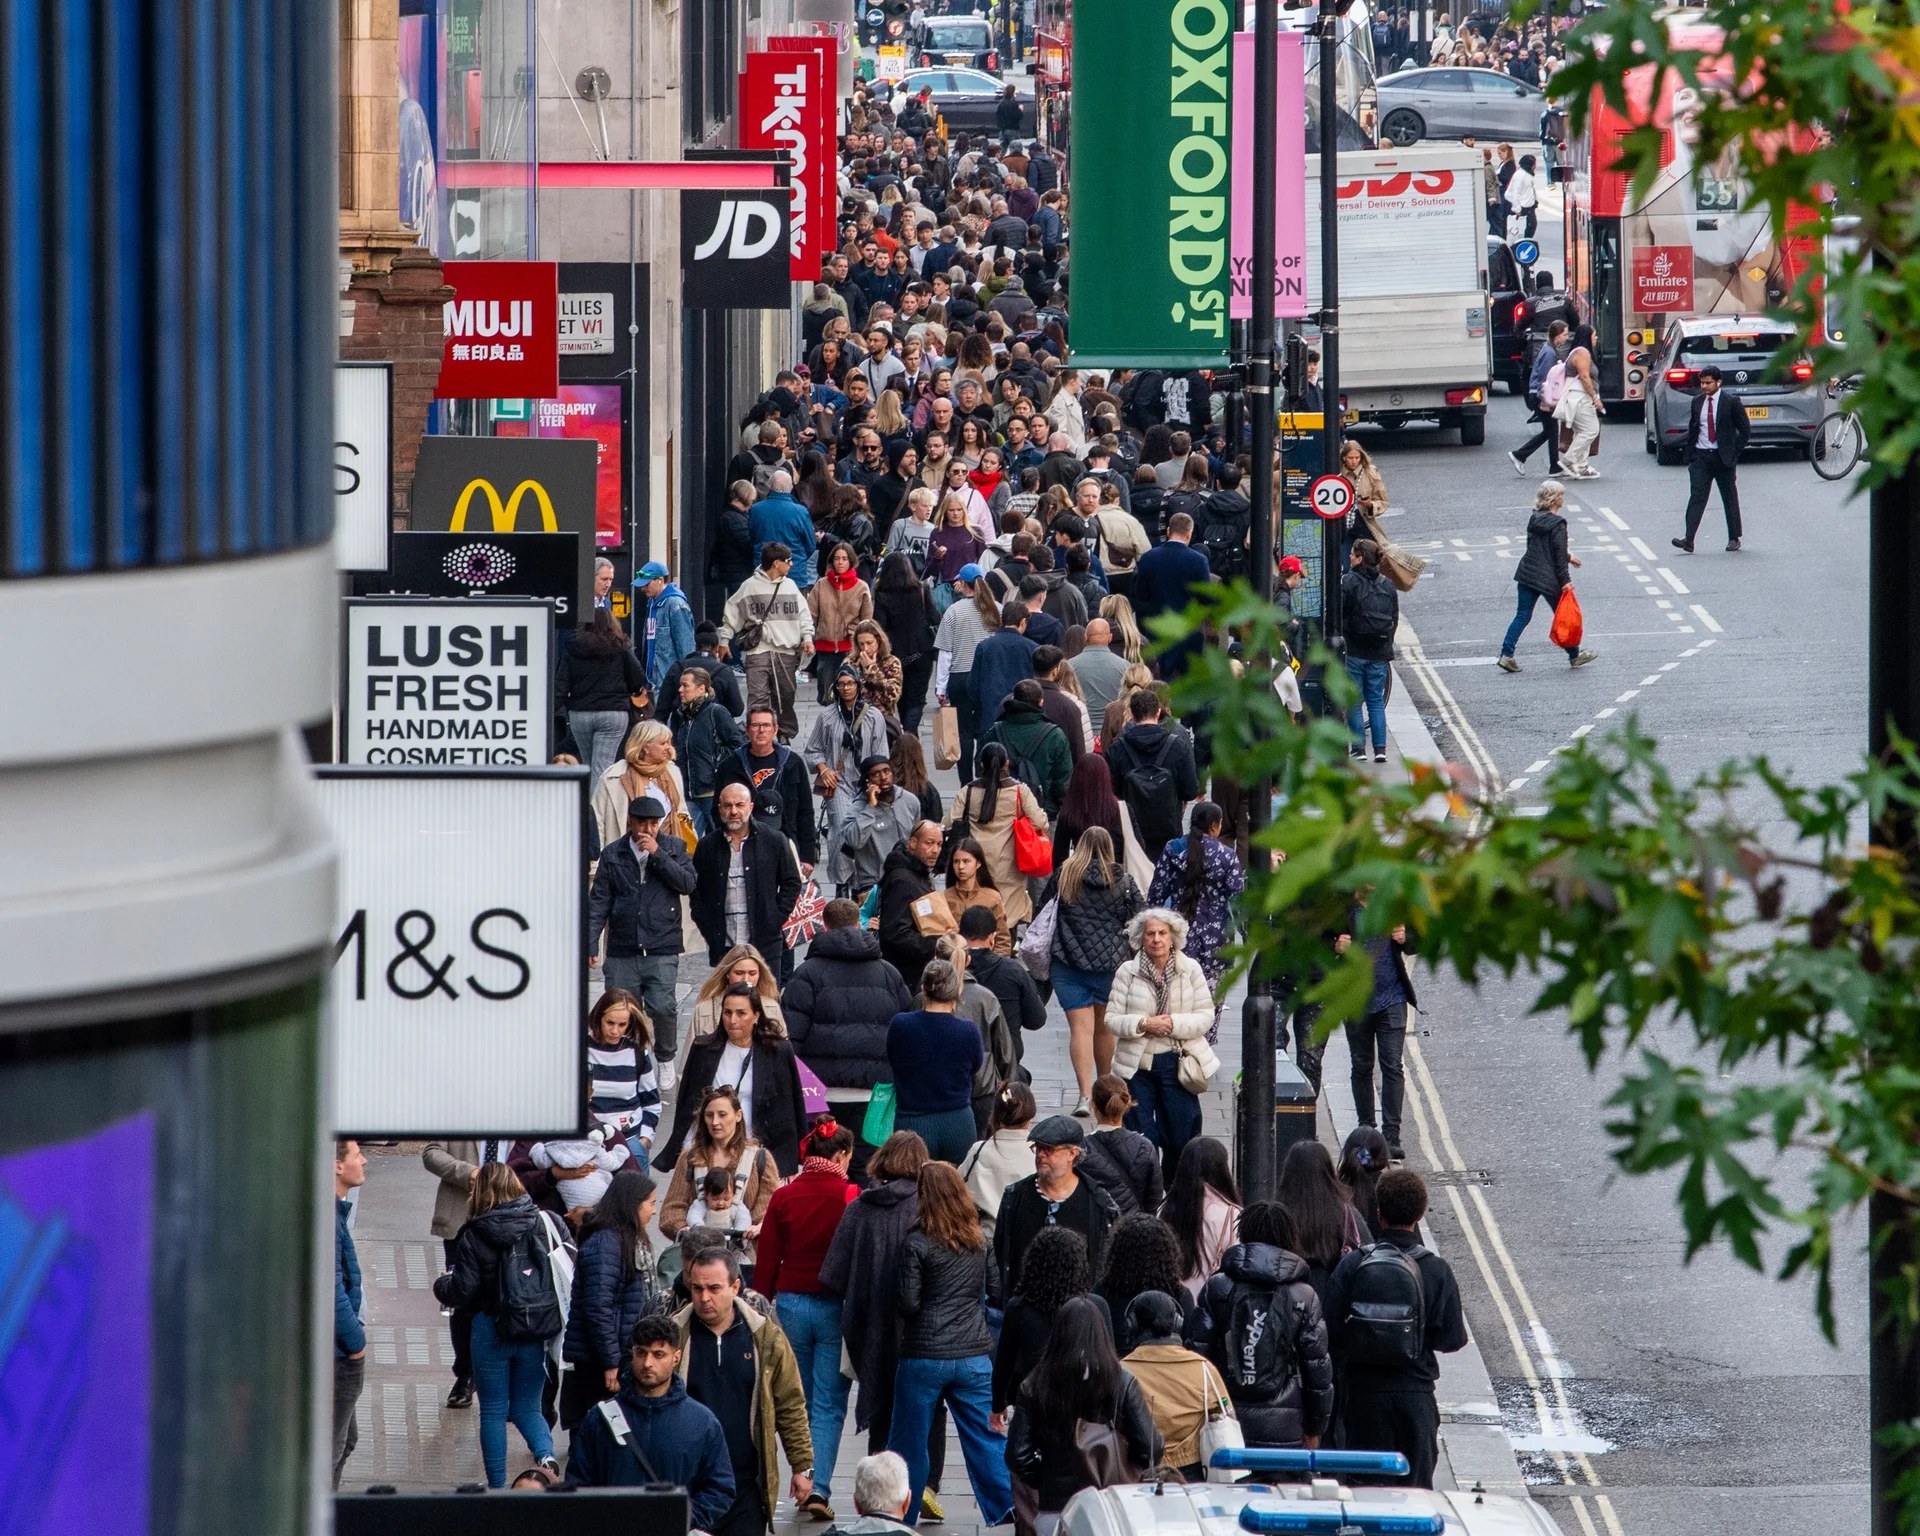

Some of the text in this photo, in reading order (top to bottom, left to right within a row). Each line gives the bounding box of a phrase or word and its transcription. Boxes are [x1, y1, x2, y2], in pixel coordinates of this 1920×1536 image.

[1169, 0, 1229, 285] OXFORD
[1368, 200, 1406, 209] Delivery
[1411, 197, 1456, 207] Solutions
[1700, 181, 1732, 206] 55
[694, 201, 782, 260] JD
[1638, 275, 1688, 287] Emirates
[1645, 291, 1680, 302] FLY BETTER
[443, 300, 532, 337] MUJI
[582, 319, 603, 335] W1
[452, 343, 524, 361] 無印良品
[1317, 487, 1347, 506] 20
[366, 626, 527, 667] LUSH
[366, 676, 527, 711] FRESH
[366, 720, 527, 740] HANDMADE
[366, 746, 527, 765] COSMETICS
